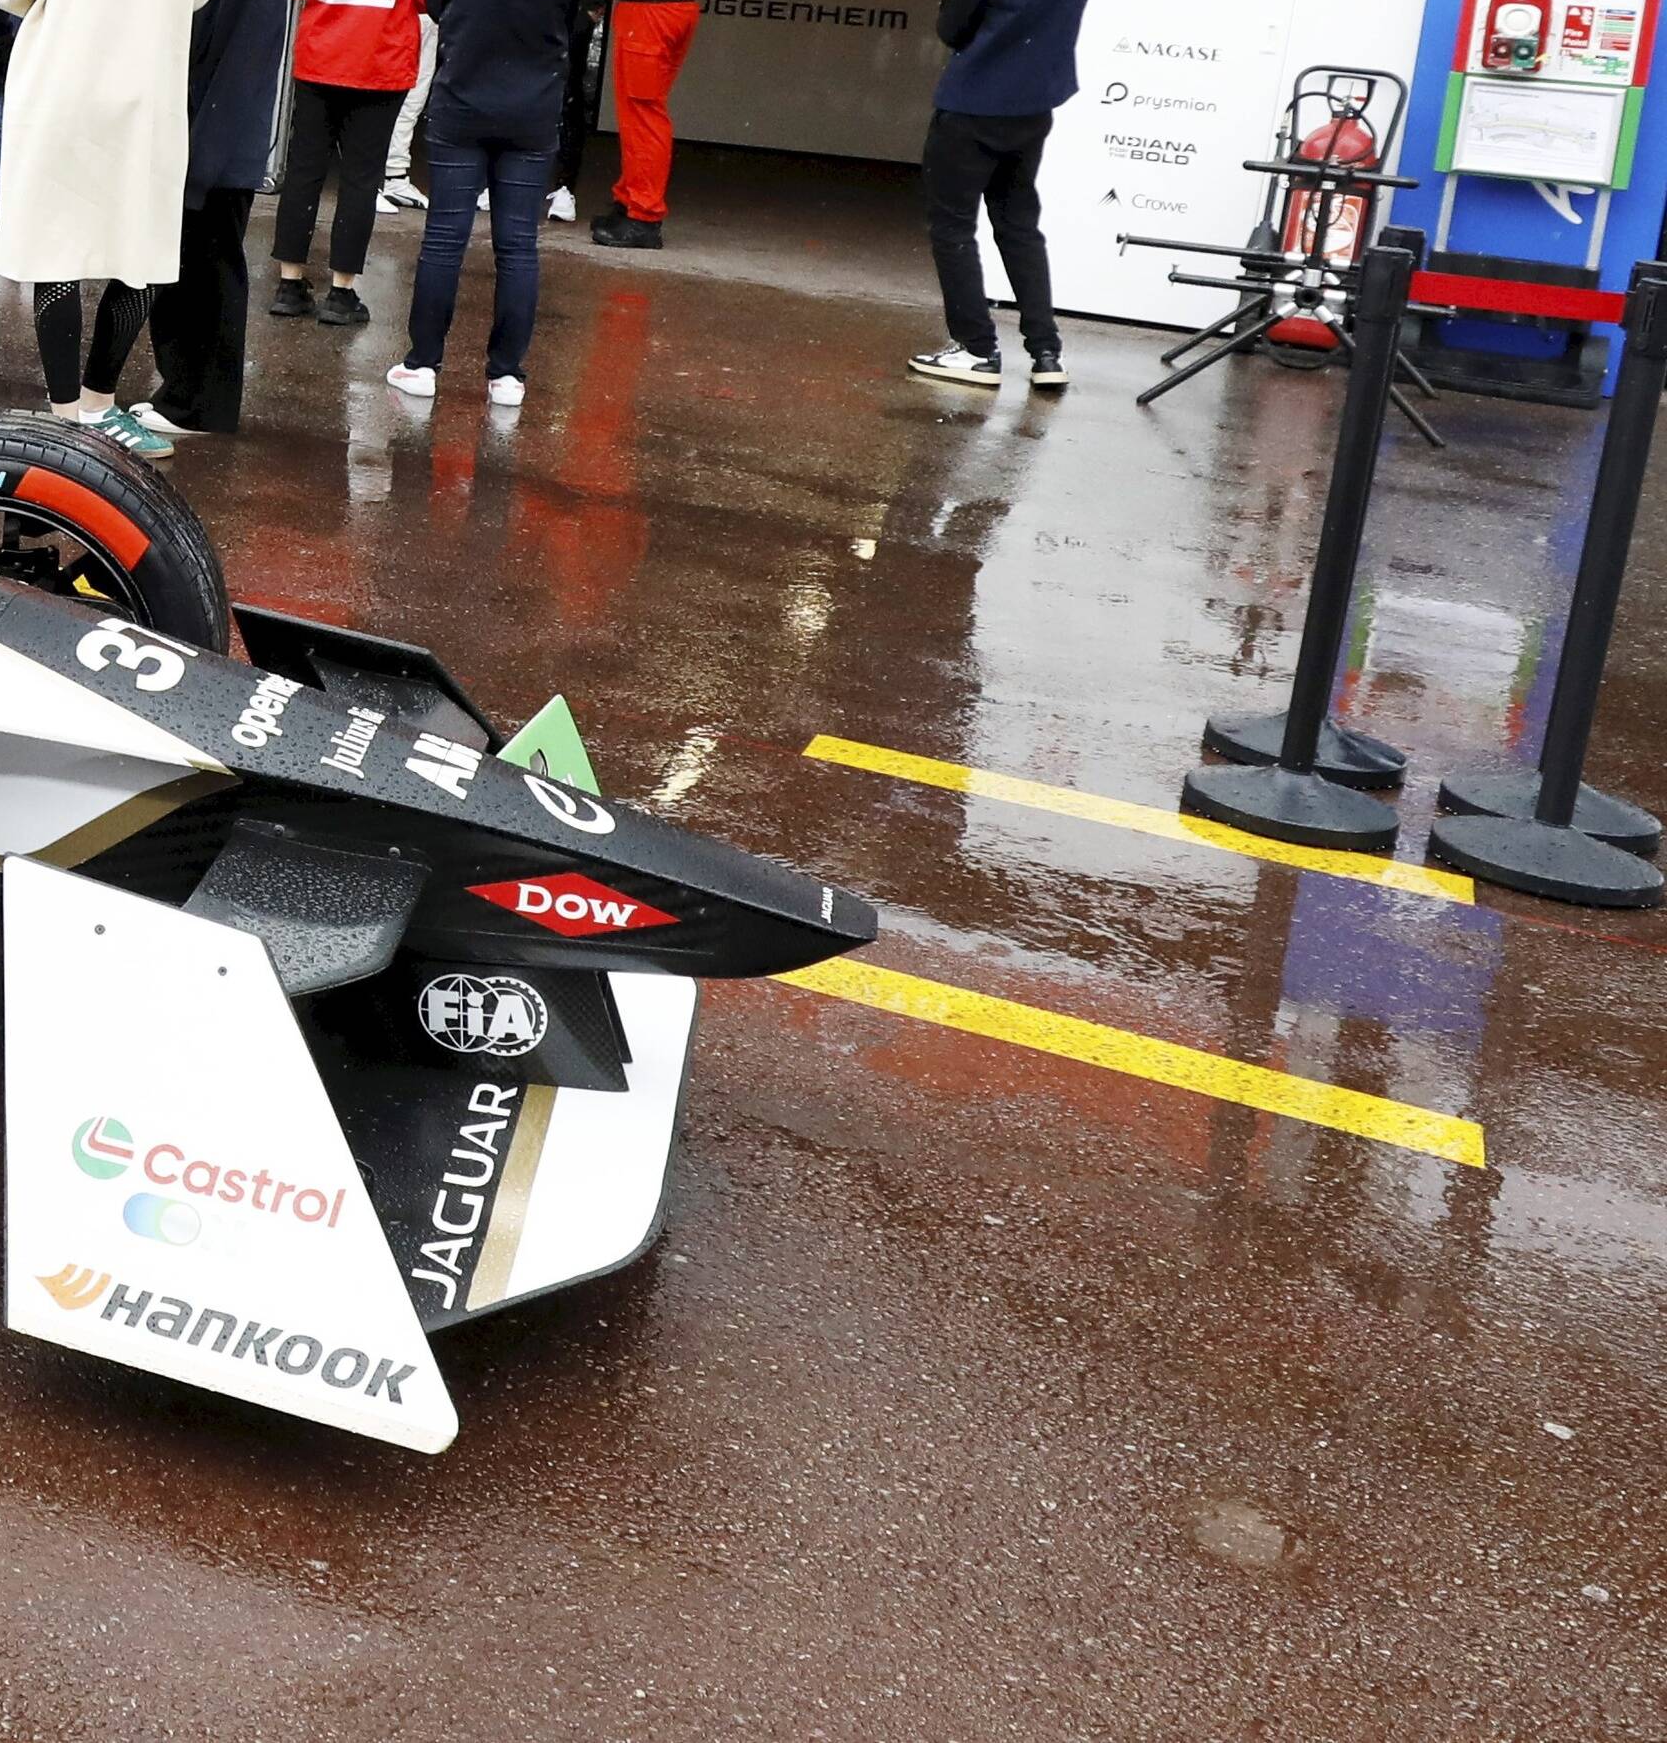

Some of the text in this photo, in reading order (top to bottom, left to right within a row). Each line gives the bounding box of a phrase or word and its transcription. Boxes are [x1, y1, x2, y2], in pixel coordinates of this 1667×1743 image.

[1136, 40, 1223, 62] NAGASE
[1133, 94, 1218, 113] prysmian
[1104, 133, 1198, 154] INDIANA
[1130, 149, 1190, 166] BOLD
[1131, 193, 1189, 214] Crowe
[820, 886, 834, 925] JAGUAR
[143, 1143, 347, 1229] Castrol
[411, 1082, 519, 1310] JAGUAR
